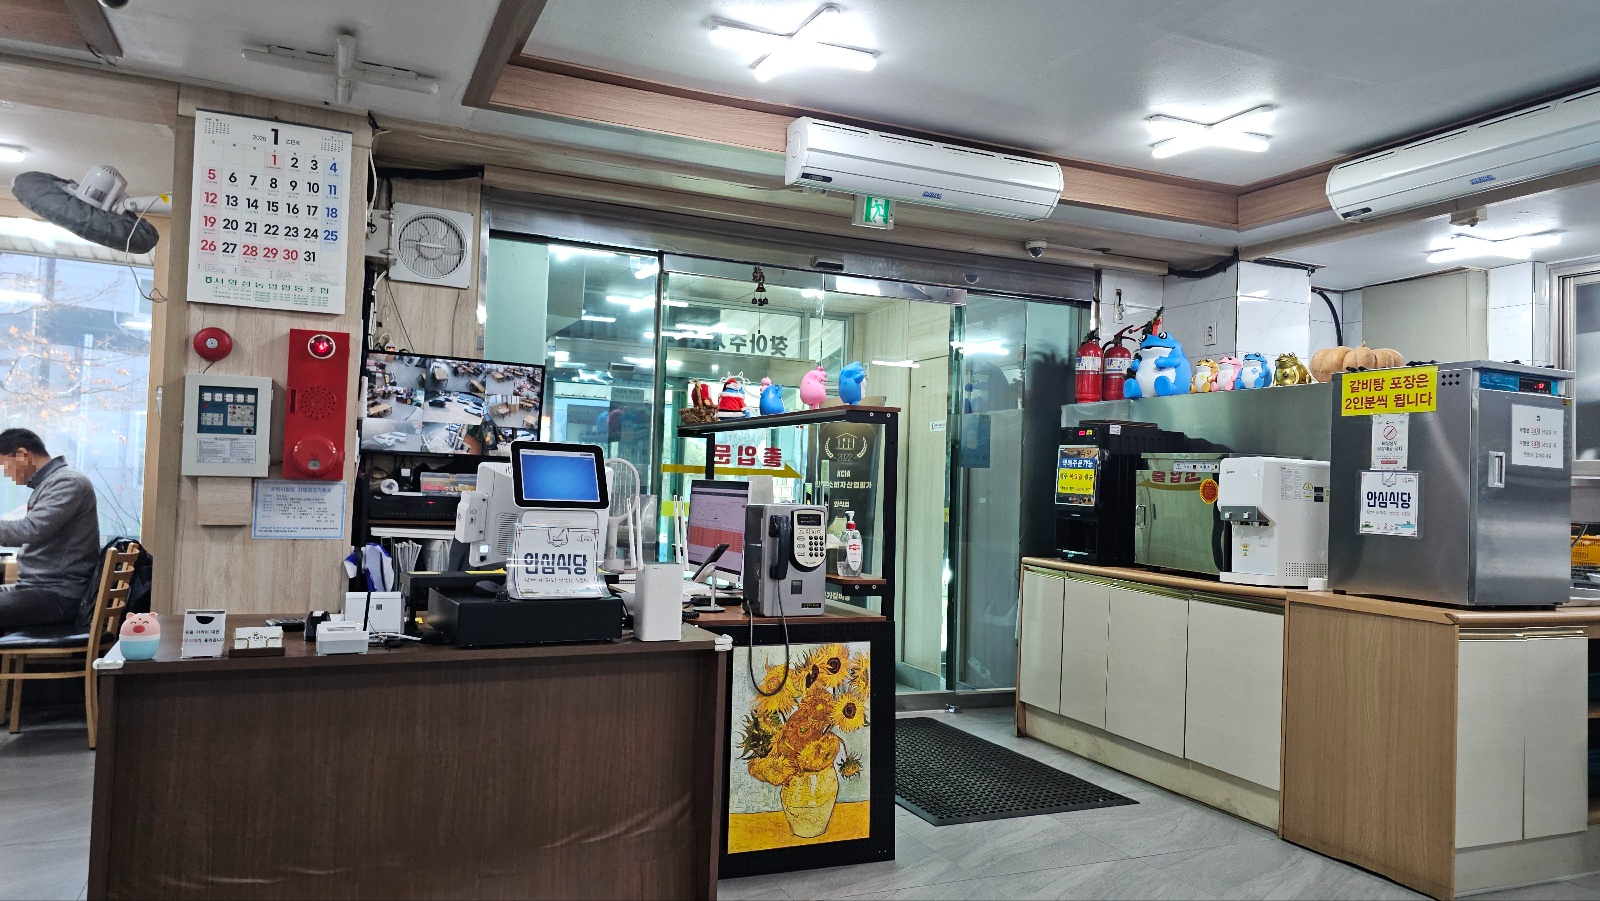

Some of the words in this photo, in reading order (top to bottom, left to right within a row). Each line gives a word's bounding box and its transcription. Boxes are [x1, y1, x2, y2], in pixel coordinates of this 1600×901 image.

[271, 128, 279, 145] 1
[271, 155, 277, 165] 1
[291, 157, 298, 168] 2
[311, 160, 318, 170] 3
[330, 163, 337, 173] 4
[208, 169, 216, 179] 5
[229, 172, 237, 183] 6
[250, 175, 257, 186] 7
[270, 178, 277, 188] 8
[290, 180, 297, 191] 9
[307, 182, 319, 193] 10
[328, 185, 336, 195] 11
[205, 192, 217, 204] 12
[226, 195, 238, 206] 13
[246, 198, 259, 210] 14
[267, 201, 278, 212] 15
[286, 203, 299, 214] 16
[307, 205, 318, 216] 17
[326, 207, 337, 218] 18
[204, 216, 216, 227] 19
[223, 218, 238, 230] 20
[245, 222, 257, 233] 21
[264, 224, 279, 235] 22
[284, 226, 298, 237] 23
[304, 228, 319, 239] 24
[324, 230, 338, 241] 25
[201, 240, 216, 251] 26
[222, 242, 237, 253] 27
[243, 245, 258, 256] 28
[263, 247, 278, 258] 29
[283, 249, 298, 260] 30
[304, 251, 315, 262] 31
[1349, 377, 1386, 393] 갈비탕
[1389, 373, 1429, 390] 포장은
[1345, 394, 1388, 410] 2인분씩
[1394, 391, 1433, 407] 됩니다
[838, 453, 853, 462] 2022
[1367, 491, 1411, 509] 안심식당
[524, 553, 587, 575] 안심식당
